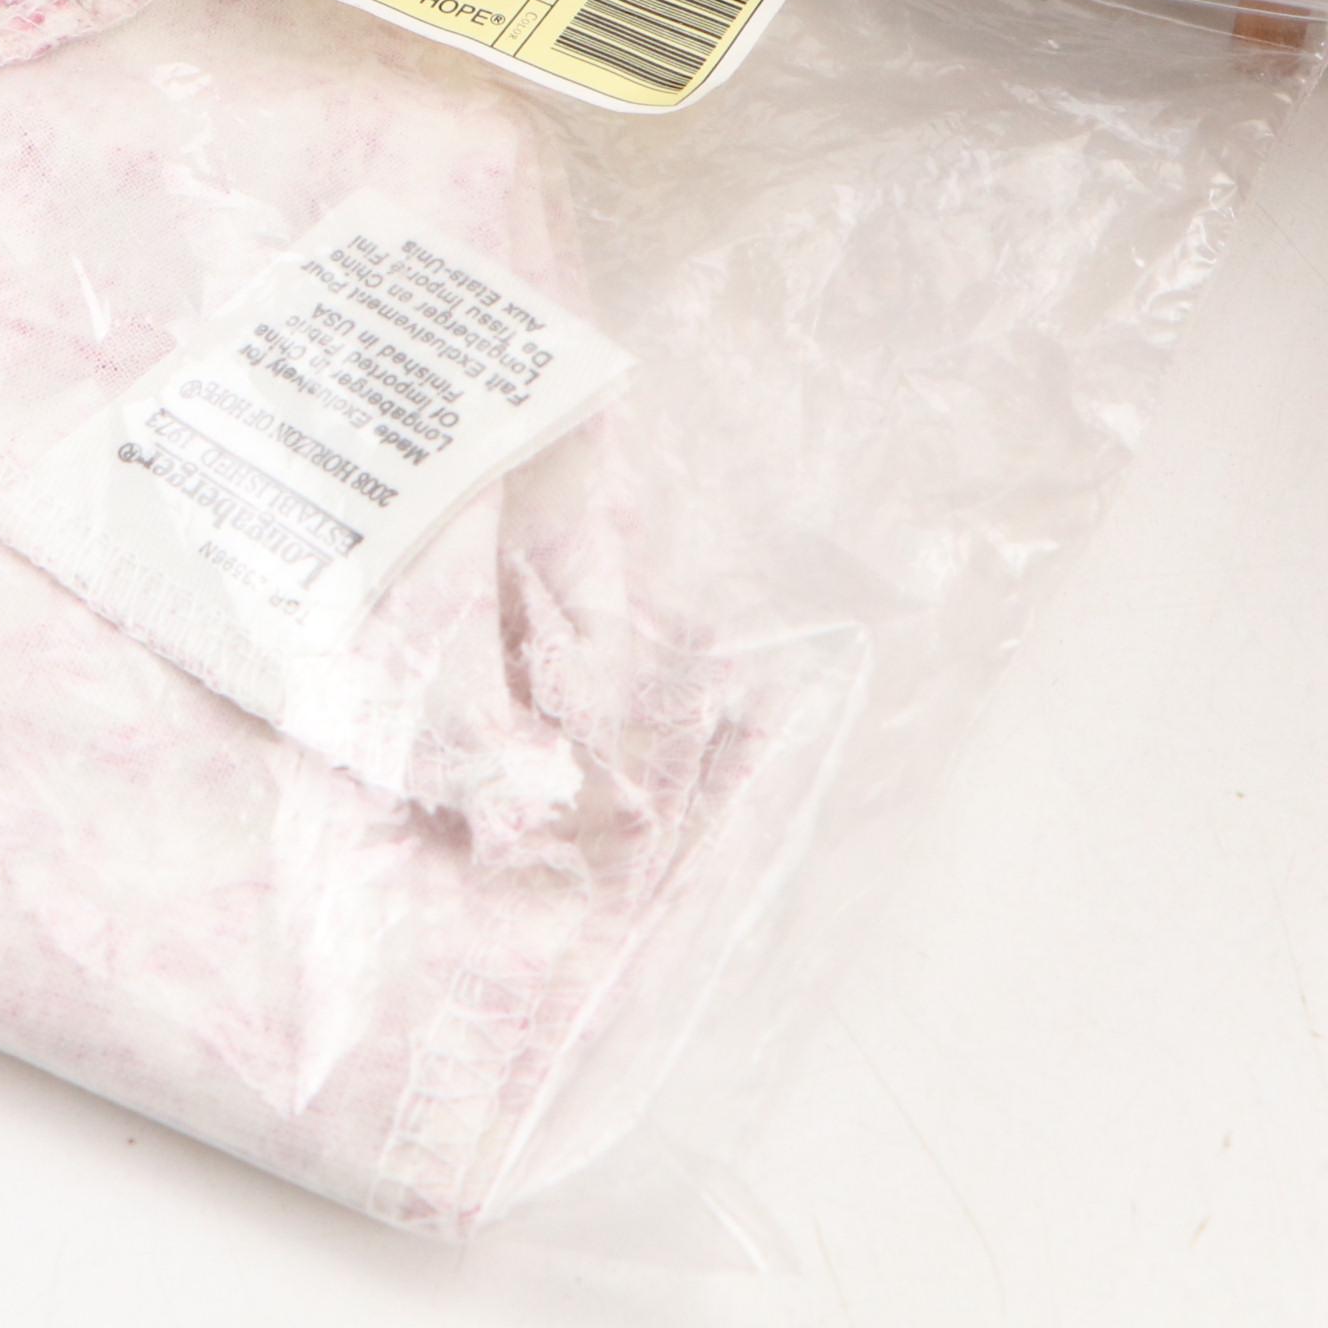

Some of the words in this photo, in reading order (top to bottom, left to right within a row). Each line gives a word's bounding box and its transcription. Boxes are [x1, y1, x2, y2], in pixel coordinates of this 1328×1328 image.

[328, 248, 385, 289] Chine
[346, 234, 391, 267] Fini
[299, 259, 349, 295] Pour
[386, 283, 415, 304] en
[284, 314, 343, 358] Fabric
[310, 302, 357, 337] USA
[345, 286, 487, 379] Exclusivement
[464, 304, 517, 350] Tissu
[501, 301, 547, 333] Aux
[237, 343, 267, 368] for
[253, 322, 307, 361] China
[356, 329, 381, 351] in
[413, 301, 542, 387] Longaberger
[521, 341, 555, 370] De
[264, 356, 373, 430] Exclusively
[342, 350, 433, 415] Imported
[375, 343, 465, 405] Finished
[484, 373, 532, 408] Fait
[143, 410, 199, 449] 1973
[241, 402, 276, 433] OF
[329, 369, 455, 454] Longaberger
[428, 406, 461, 429] Of
[276, 421, 360, 484] HORIZON
[373, 424, 431, 467] Made
[201, 445, 365, 559] ESTABLISHED
[350, 471, 400, 509] 2008
